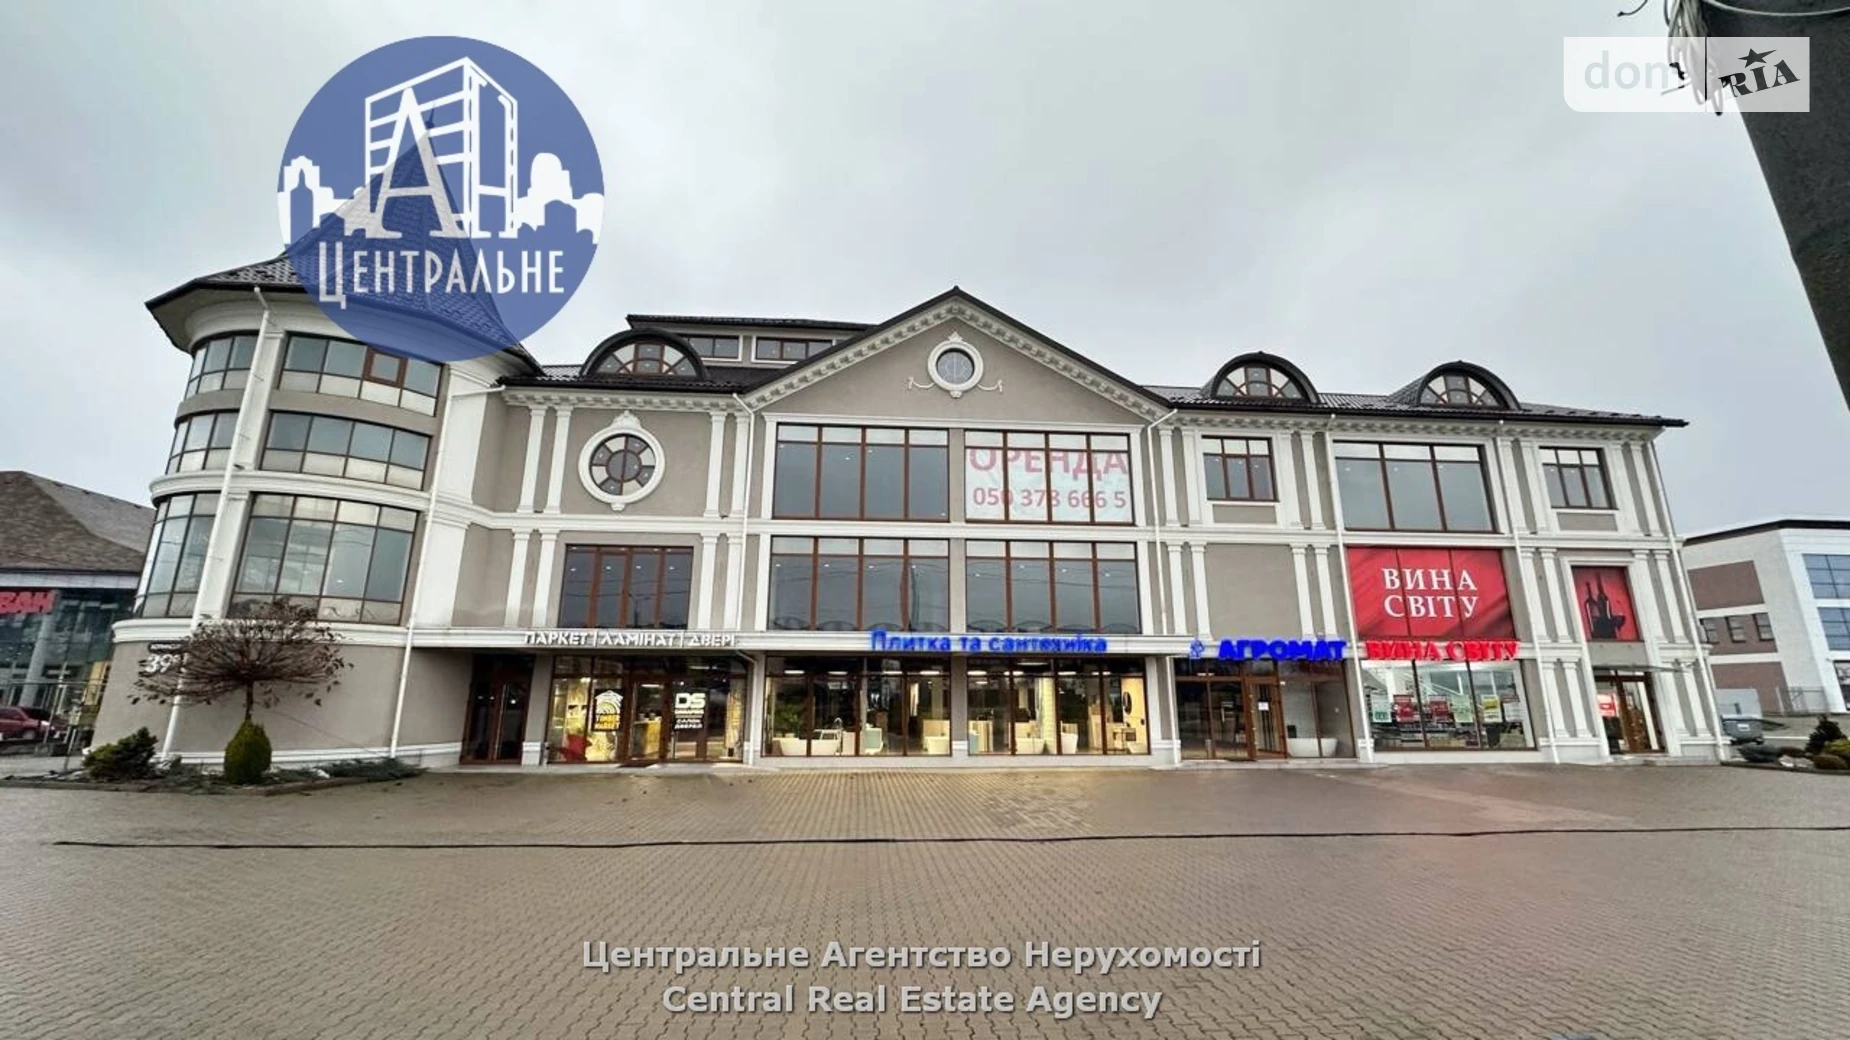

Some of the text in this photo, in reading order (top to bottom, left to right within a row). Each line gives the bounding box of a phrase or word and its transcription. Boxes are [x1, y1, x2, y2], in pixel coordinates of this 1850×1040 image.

[969, 447, 1129, 481] ОРЕНДА
[973, 487, 1014, 506] 050
[1067, 490, 1108, 509] 666
[1114, 491, 1126, 509] 5
[1382, 567, 1478, 591] ВИНА
[1384, 594, 1480, 618] СВІТУ
[524, 631, 735, 647] ПАРКЕТ ЛАМІНАТ ДВЕРІ
[871, 628, 1108, 654] Плитка та сантехніка
[1217, 638, 1348, 661] АГРОМАТ
[1365, 639, 1518, 662] ВИНА СВІТУ
[675, 692, 706, 709] DS
